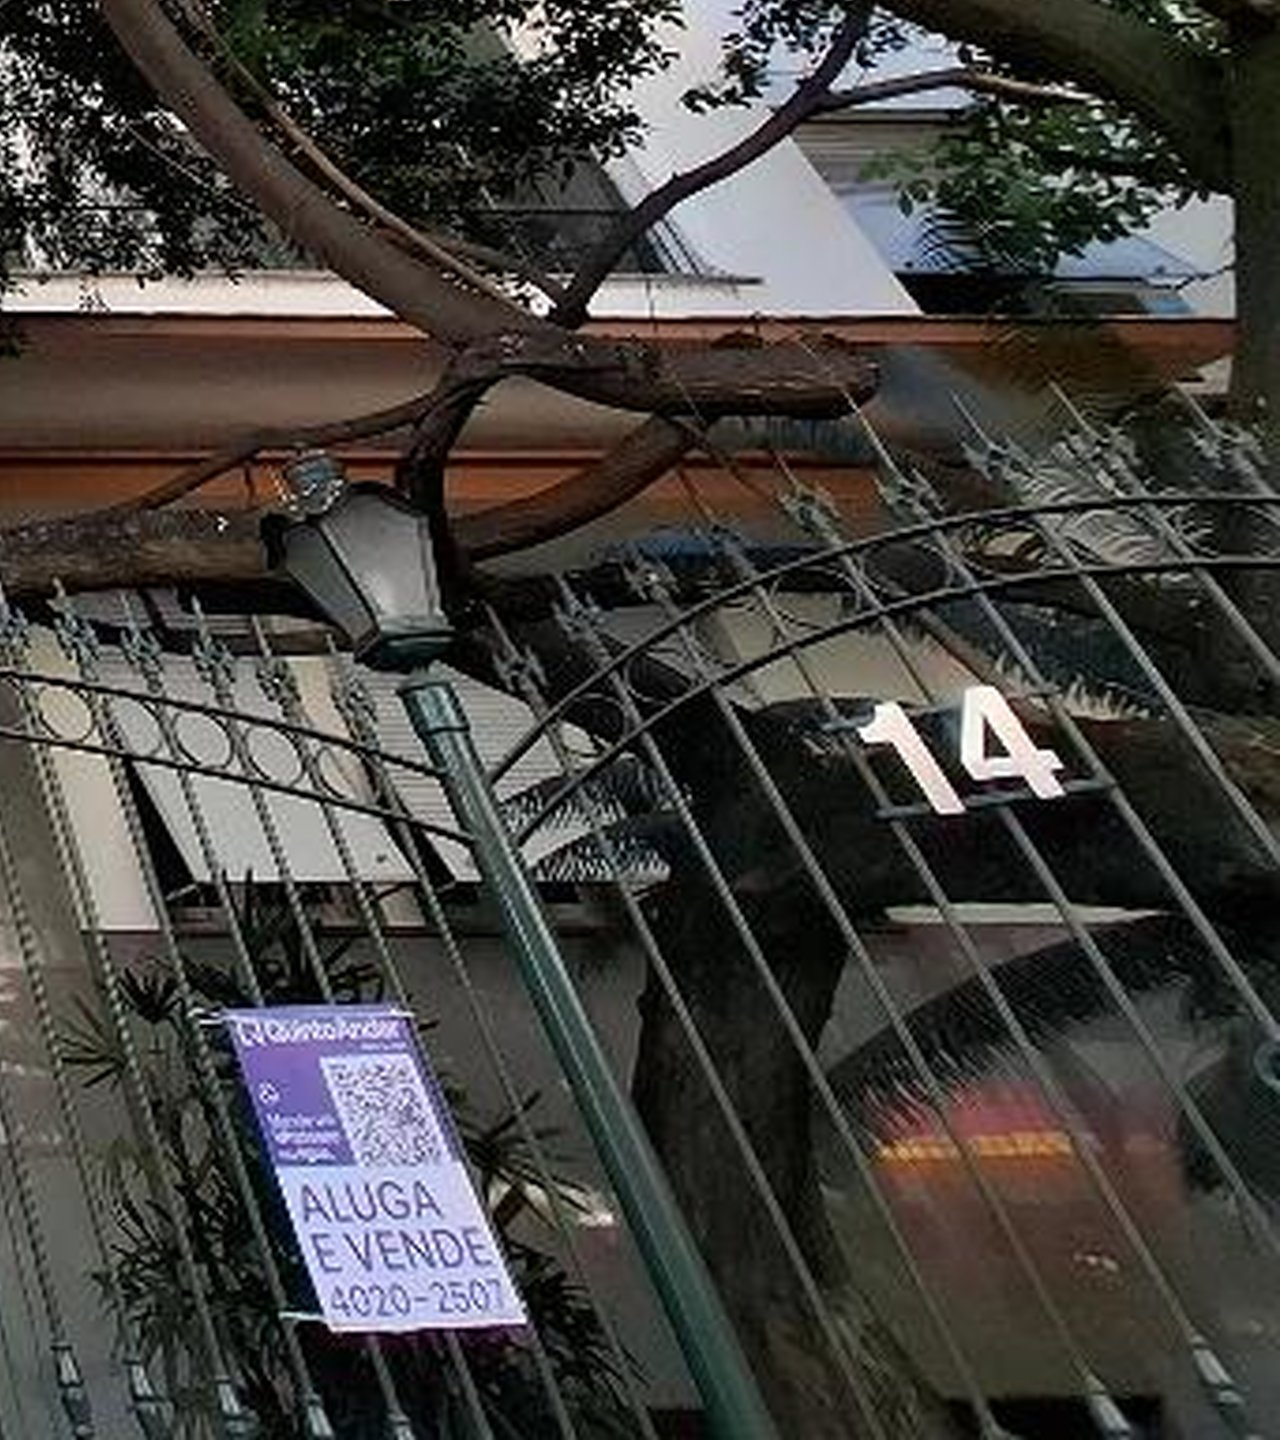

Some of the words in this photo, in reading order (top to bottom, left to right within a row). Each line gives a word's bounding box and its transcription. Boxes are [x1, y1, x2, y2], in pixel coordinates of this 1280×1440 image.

[856, 685, 1067, 815] 14
[300, 1181, 443, 1223] ALUGA
[311, 1232, 342, 1273] E
[344, 1227, 493, 1272] VENDE
